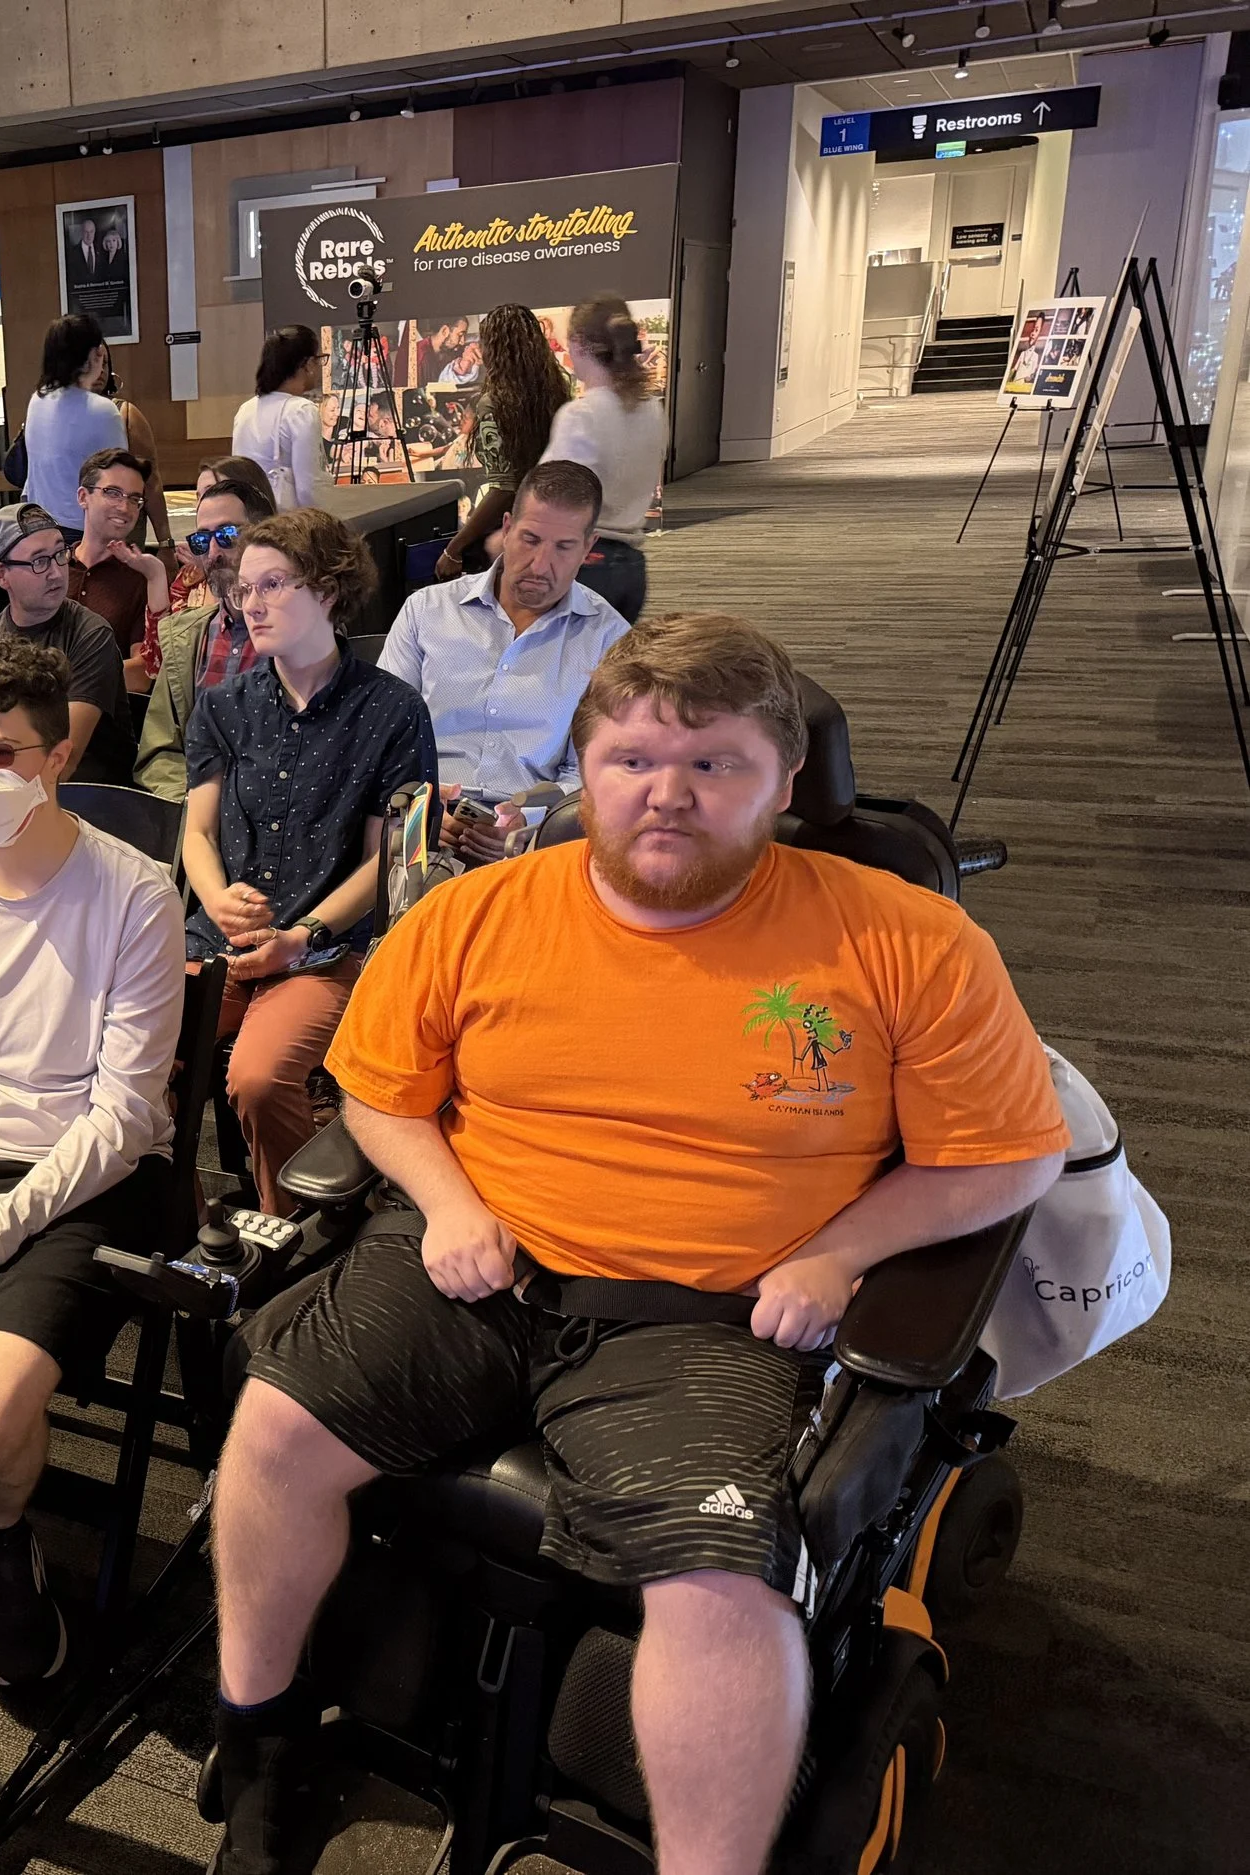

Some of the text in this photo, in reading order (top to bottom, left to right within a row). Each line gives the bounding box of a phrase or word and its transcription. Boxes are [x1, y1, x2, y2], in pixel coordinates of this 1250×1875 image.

[833, 117, 856, 126] LEVEL
[936, 112, 1022, 132] Restrooms
[839, 128, 847, 143] 1
[823, 143, 864, 154] BLUE WING
[413, 205, 638, 253] Authentic storytelling
[320, 240, 374, 259] Rare
[414, 241, 621, 271] for rare disease awareness
[768, 1104, 845, 1117] CAYMAN ISLANDS
[698, 1501, 755, 1520] adidas
